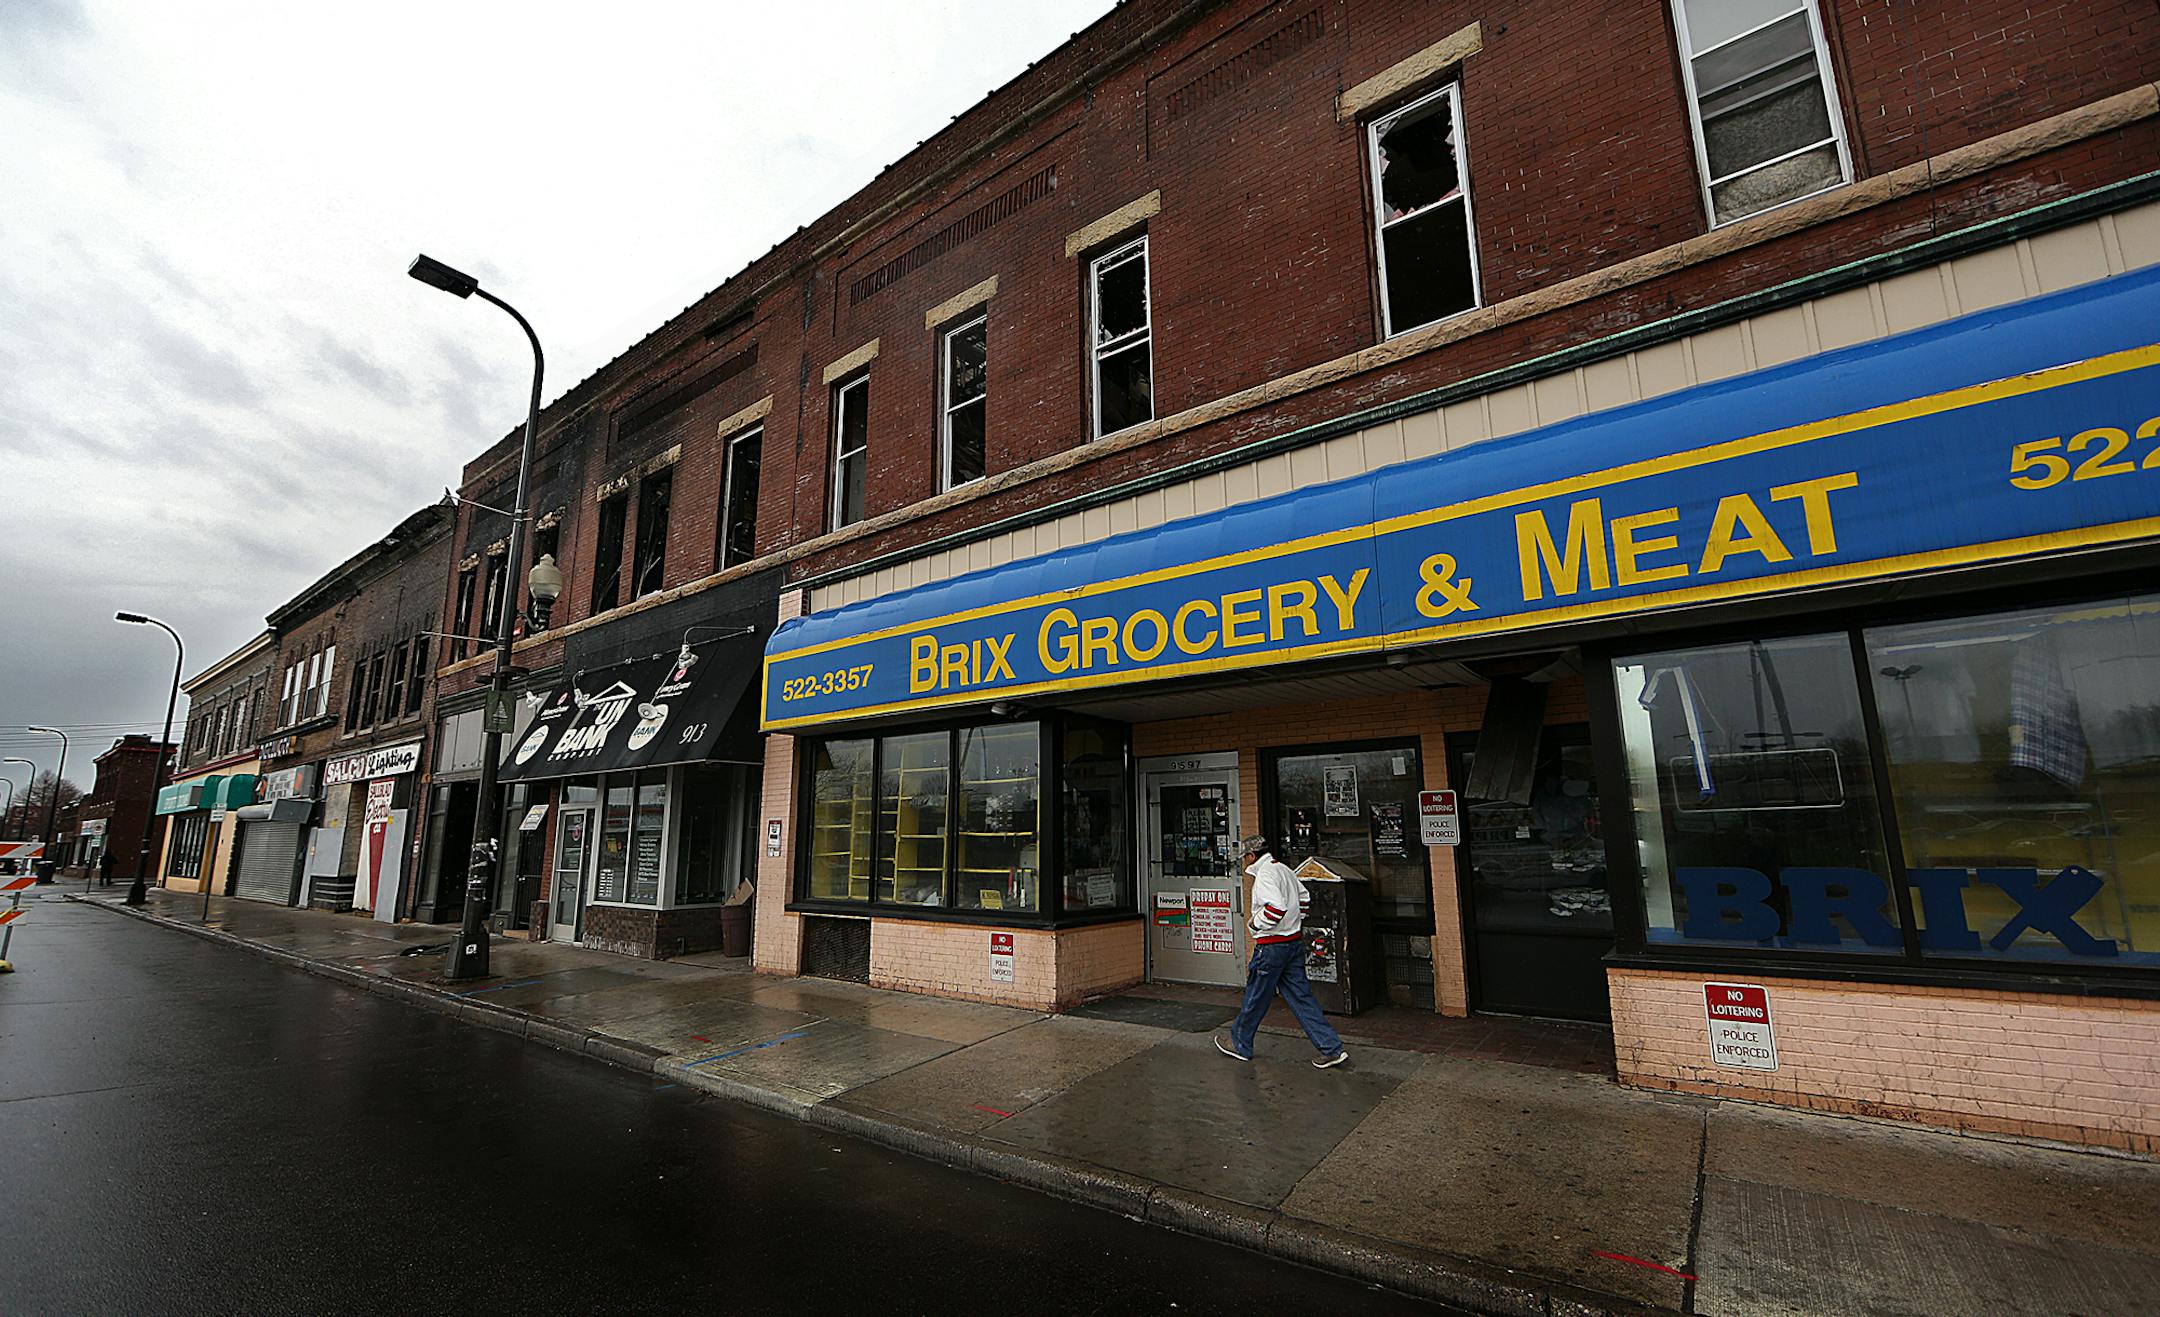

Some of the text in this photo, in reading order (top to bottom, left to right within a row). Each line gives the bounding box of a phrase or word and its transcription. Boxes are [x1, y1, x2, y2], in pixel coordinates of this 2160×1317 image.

[910, 472, 1860, 695] BRIX GROCERY & MEAT
[782, 664, 875, 703] 522-3357
[595, 697, 633, 725] UN
[551, 721, 618, 754] BANK
[678, 723, 708, 745] 913
[326, 756, 366, 783] SALCO
[1170, 760, 1202, 770] 9597
[1432, 794, 1443, 802] NO
[1423, 804, 1454, 813] LOITERING
[1429, 820, 1450, 828] POLICE
[1425, 830, 1456, 838] ENFORCED
[1676, 865, 2118, 957] BRIX
[1727, 991, 1744, 1001] NO
[1711, 1004, 1764, 1018] LOITERING
[1723, 1030, 1759, 1042] POLICE
[1717, 1044, 1770, 1059] ENFORCED
